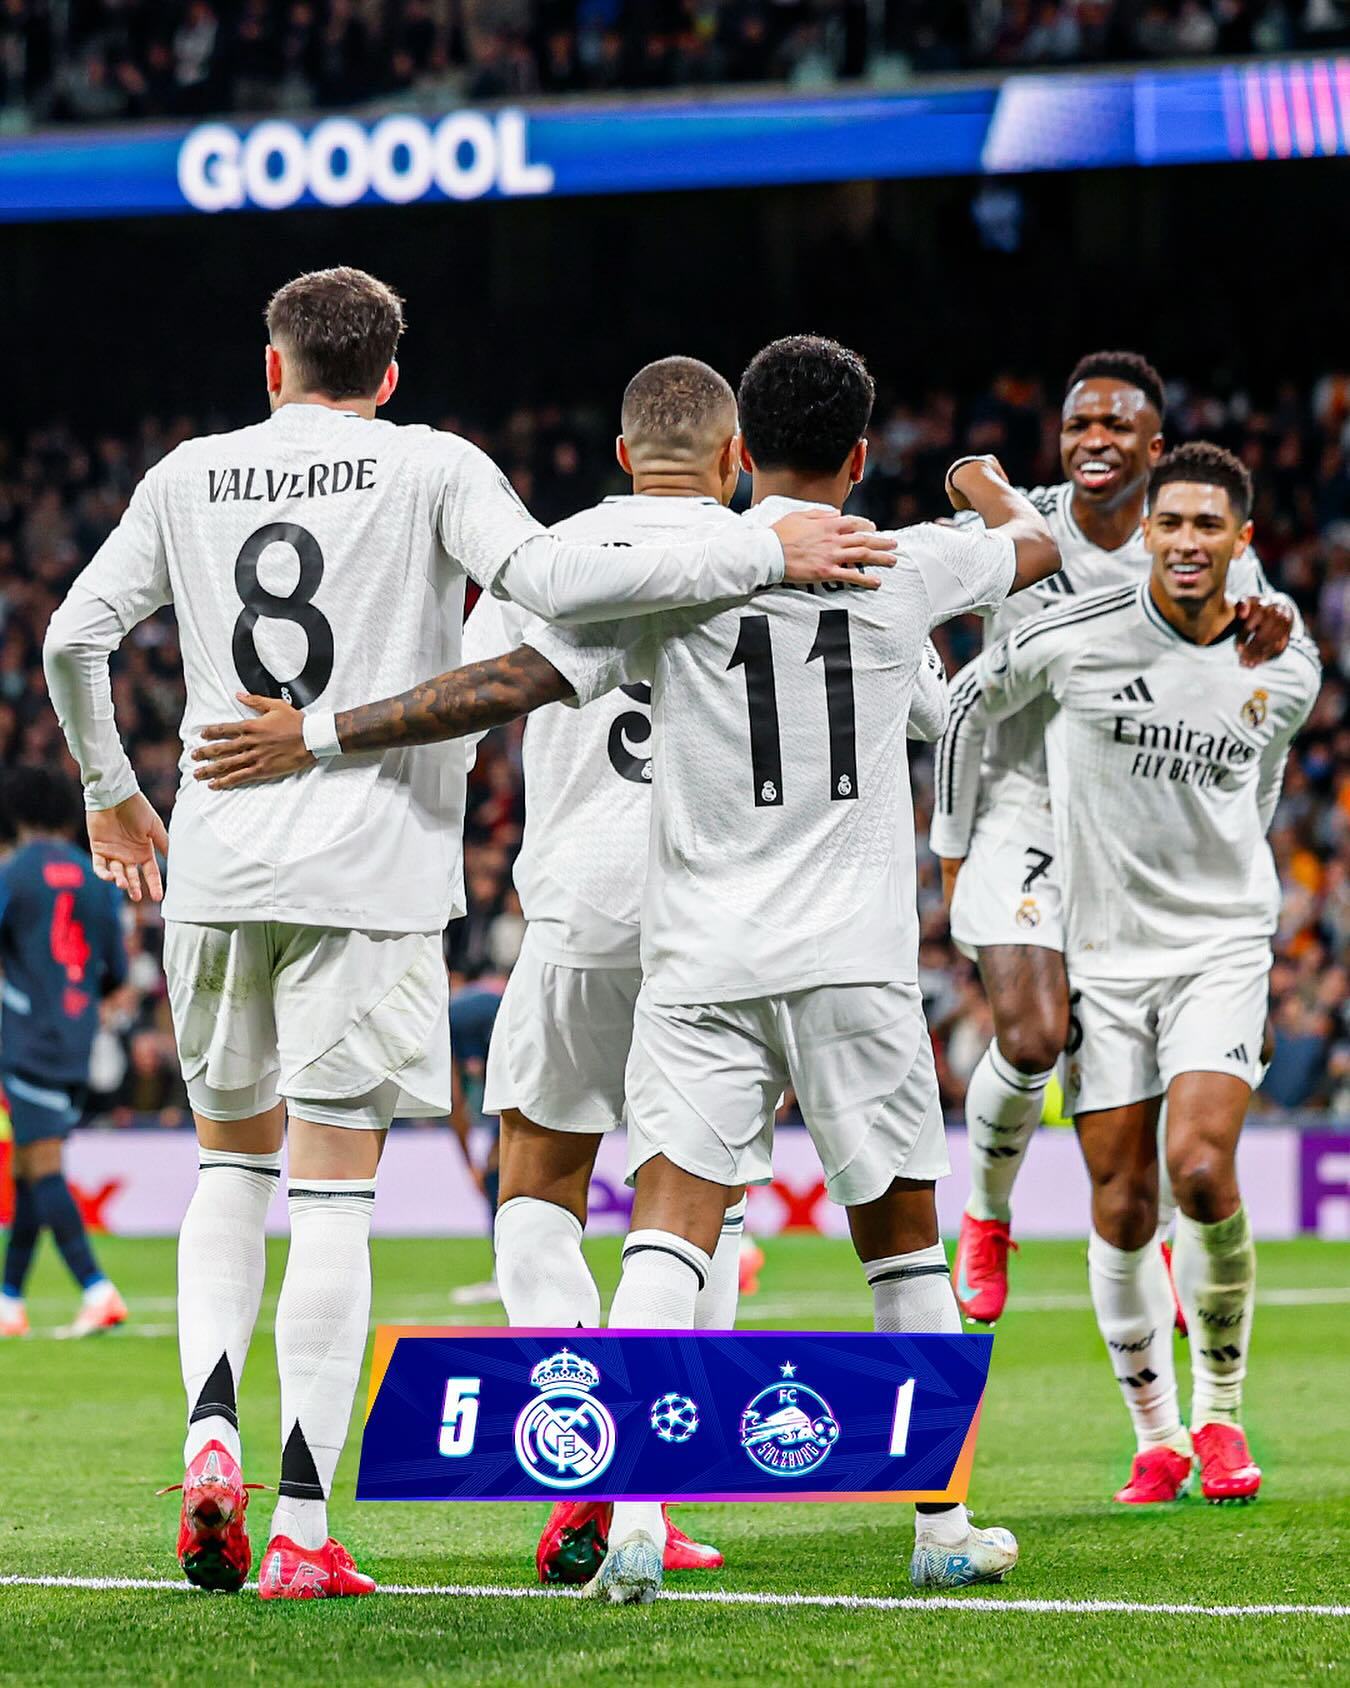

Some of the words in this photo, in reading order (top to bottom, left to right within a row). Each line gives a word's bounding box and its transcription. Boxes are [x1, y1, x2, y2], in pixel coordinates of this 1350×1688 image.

[177, 107, 556, 213] GOOOOL
[208, 458, 377, 503] VALVERDE
[232, 522, 334, 710] 8
[725, 608, 859, 807] 11
[1114, 716, 1256, 763] Emirates
[1131, 752, 1166, 779] FLY
[1022, 847, 1053, 893] 7
